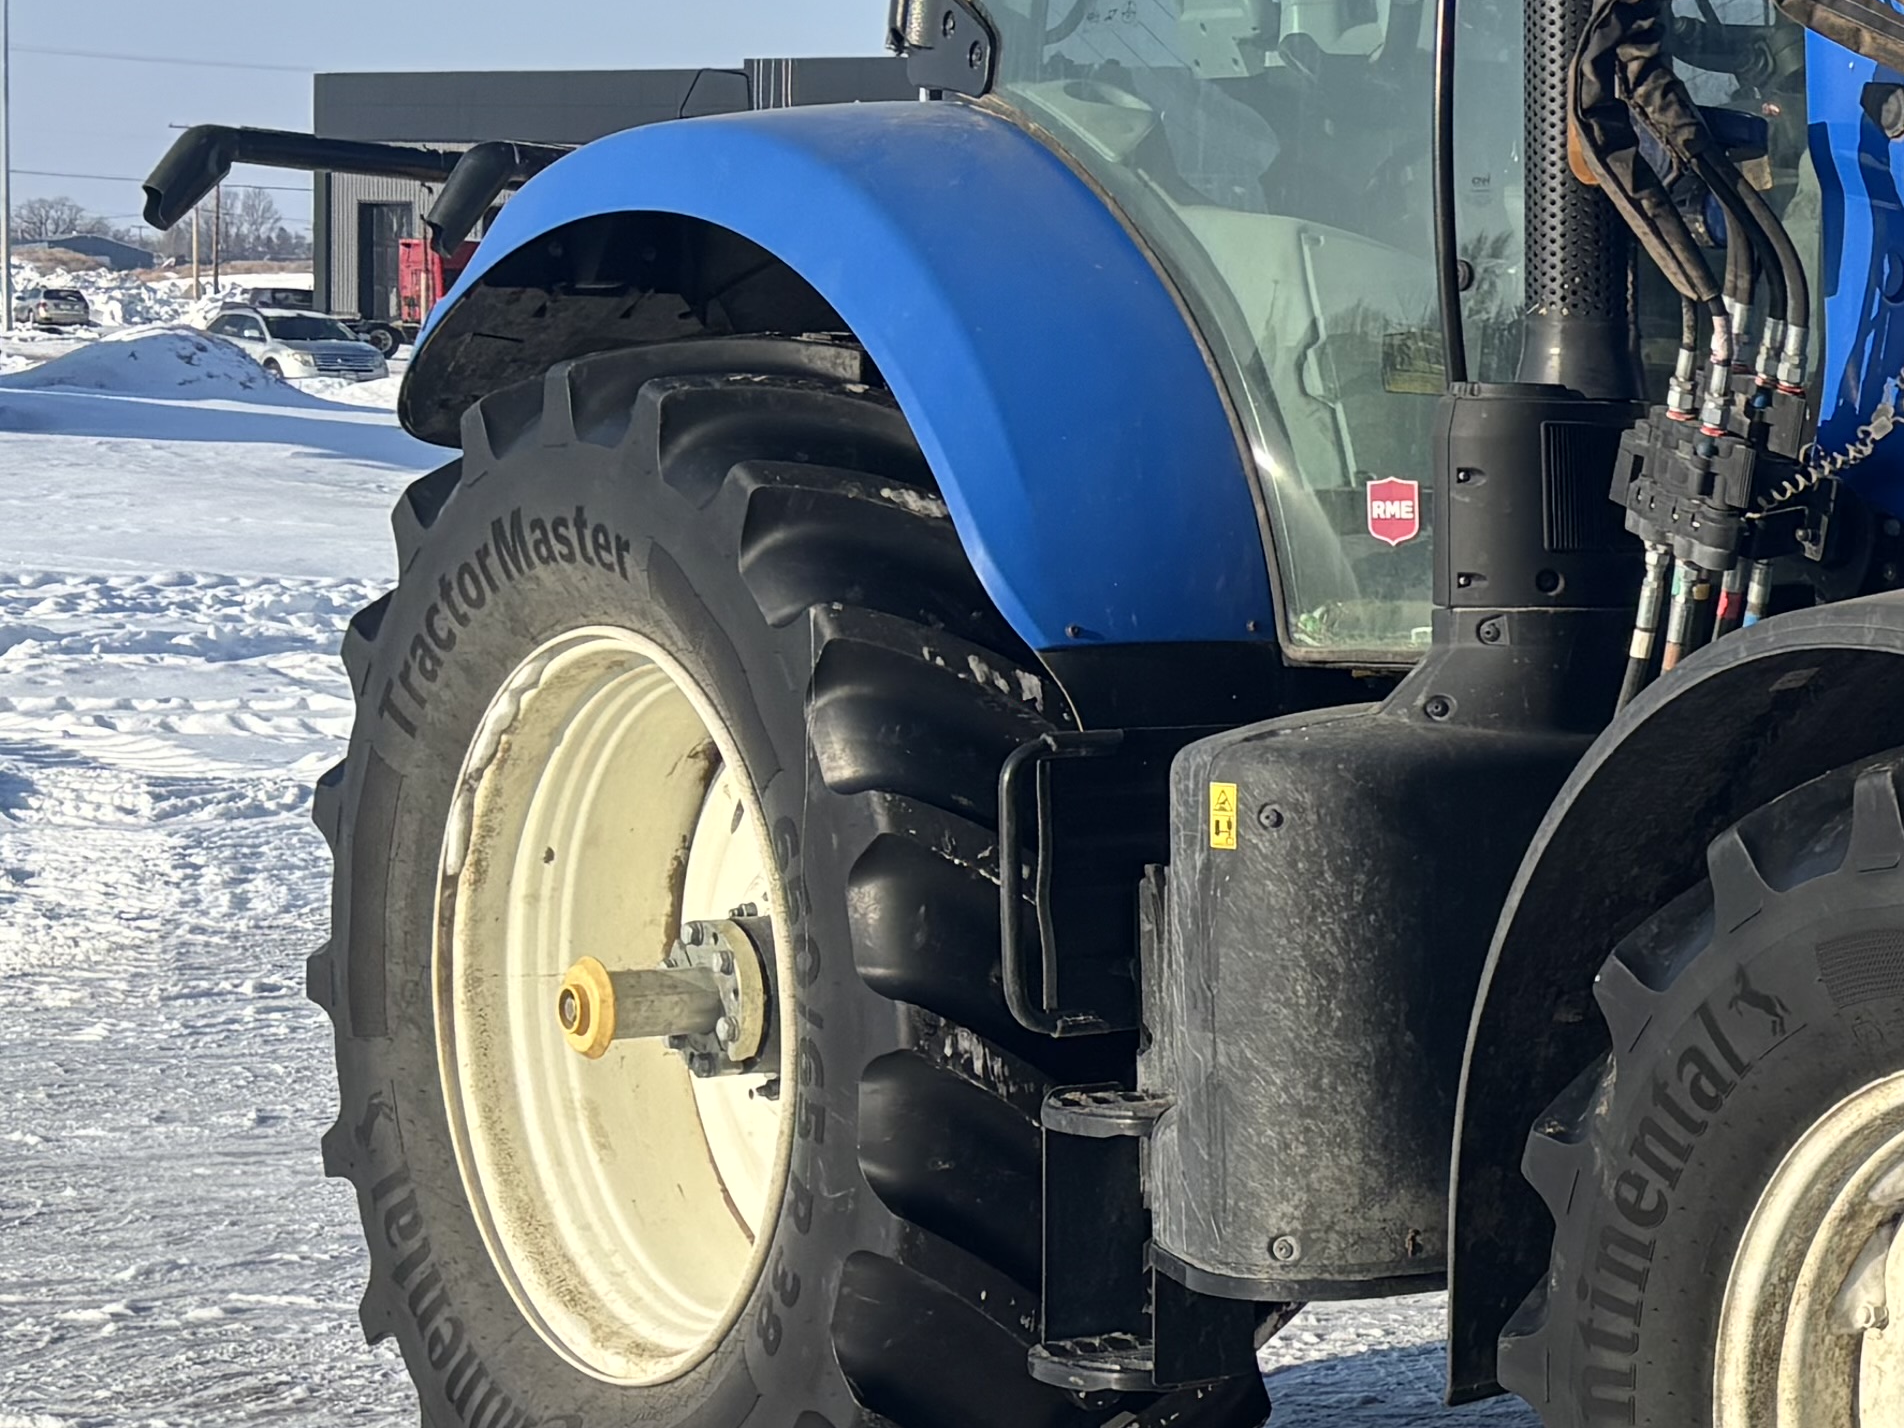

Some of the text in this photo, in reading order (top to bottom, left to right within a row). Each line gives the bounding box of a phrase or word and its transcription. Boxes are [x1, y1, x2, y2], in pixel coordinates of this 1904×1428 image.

[1371, 499, 1414, 521] RME
[378, 504, 631, 739] TractorMaster
[789, 1171, 815, 1236] R
[755, 1246, 802, 1358] 38
